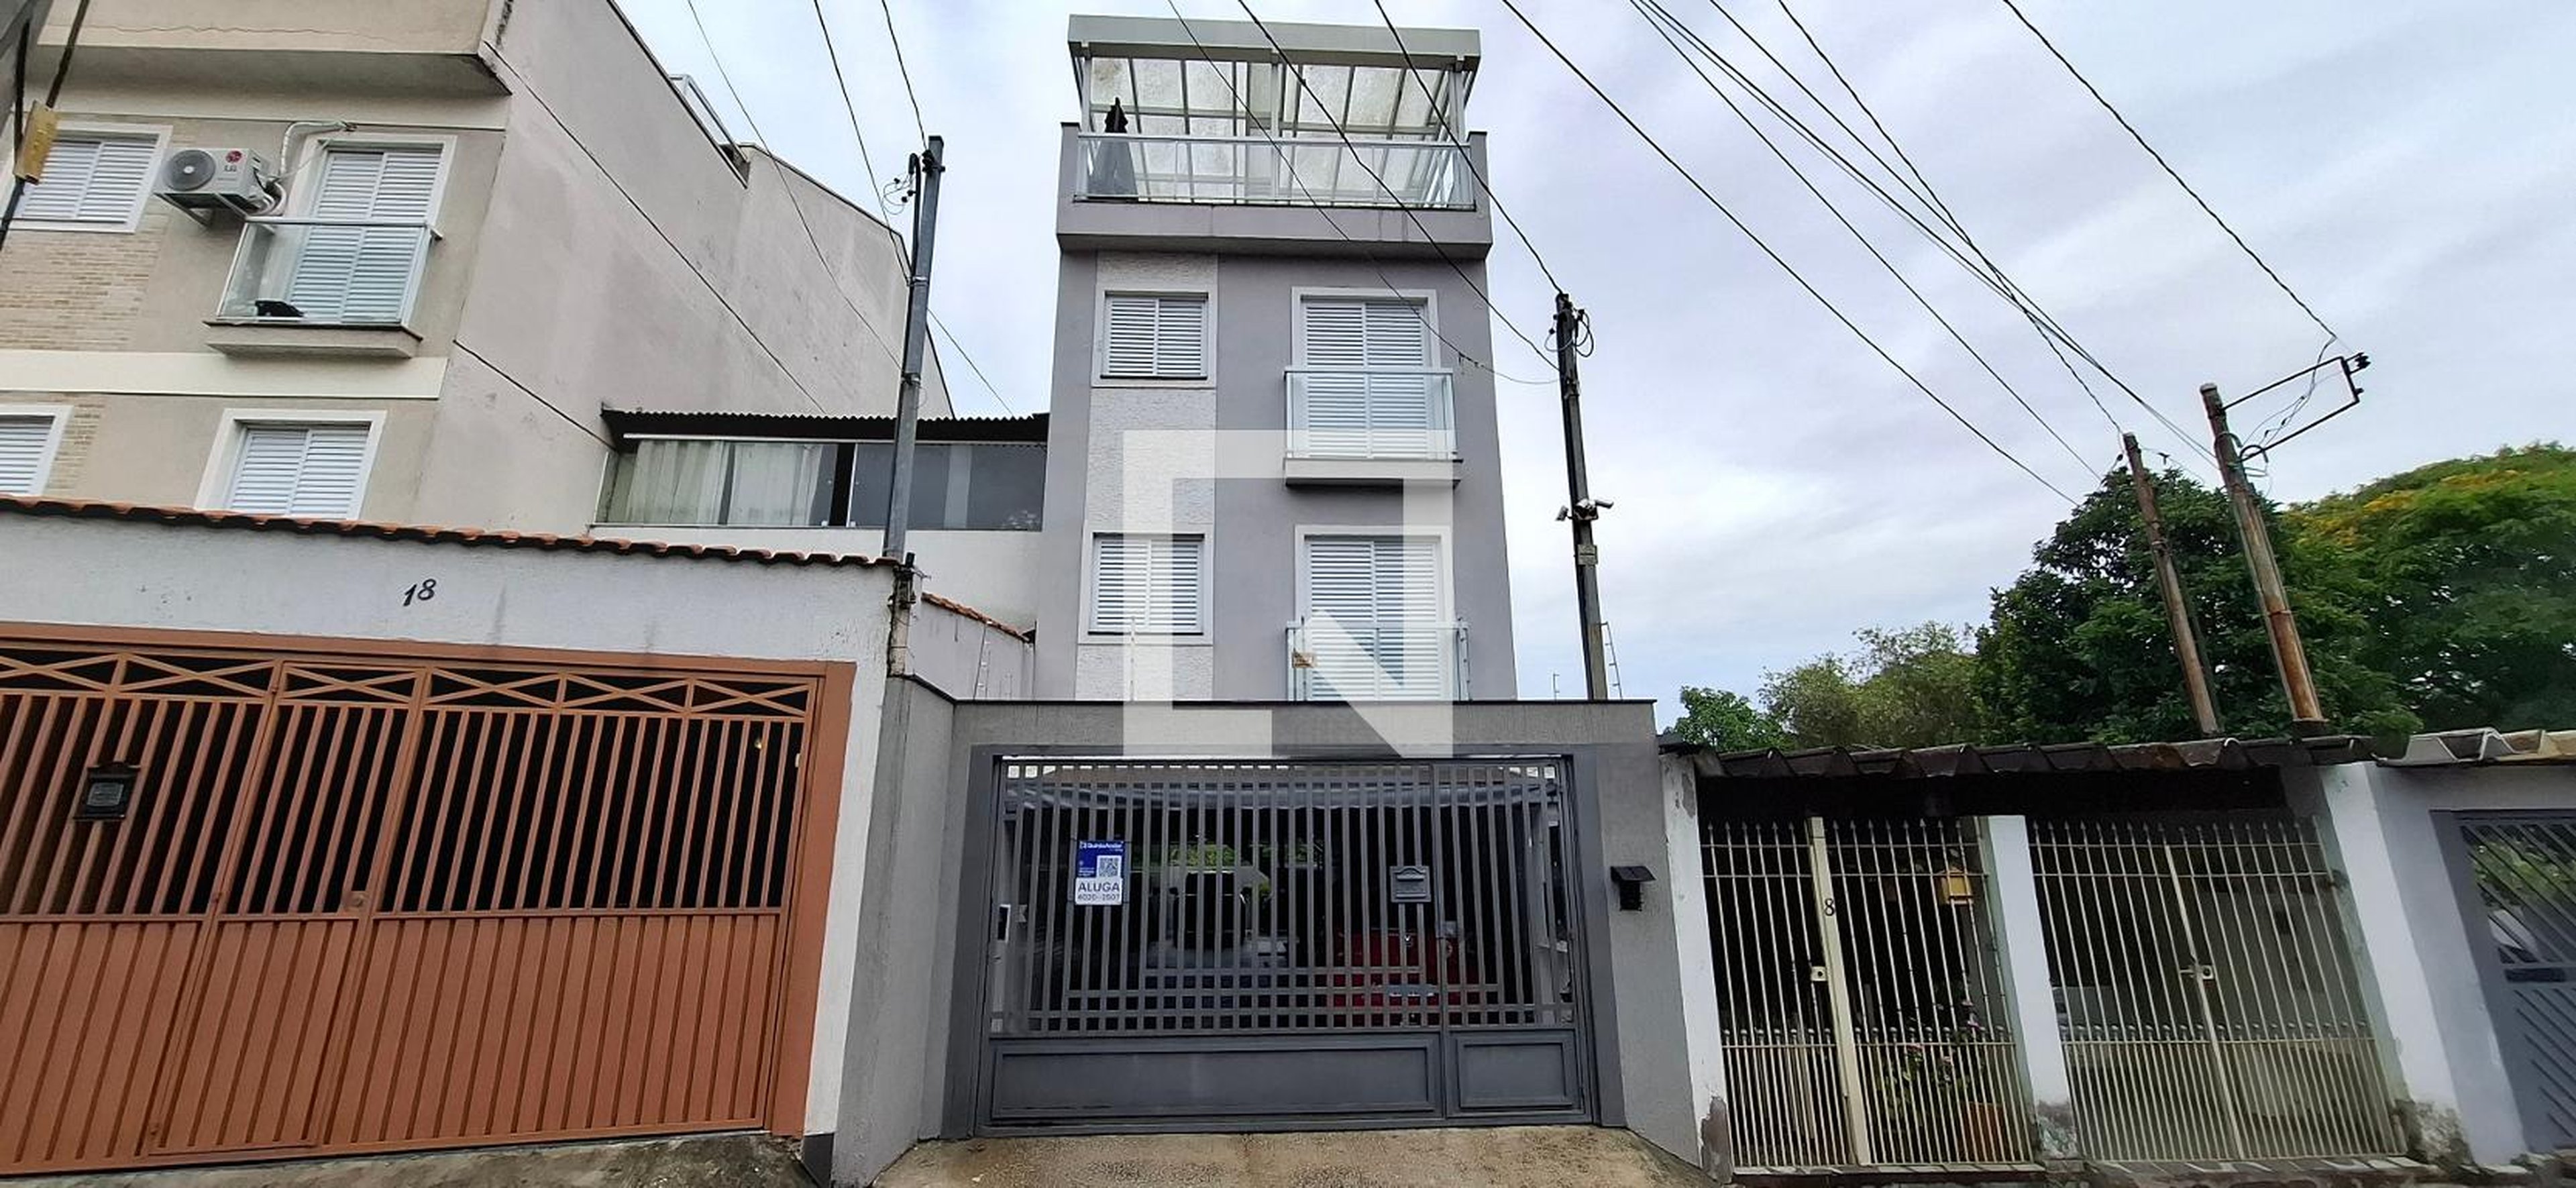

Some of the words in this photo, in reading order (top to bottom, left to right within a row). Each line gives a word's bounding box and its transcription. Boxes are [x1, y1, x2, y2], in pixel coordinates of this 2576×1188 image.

[403, 578, 436, 606] 18
[1078, 881, 1120, 892] ALUGA
[1824, 898, 1835, 916] 8
